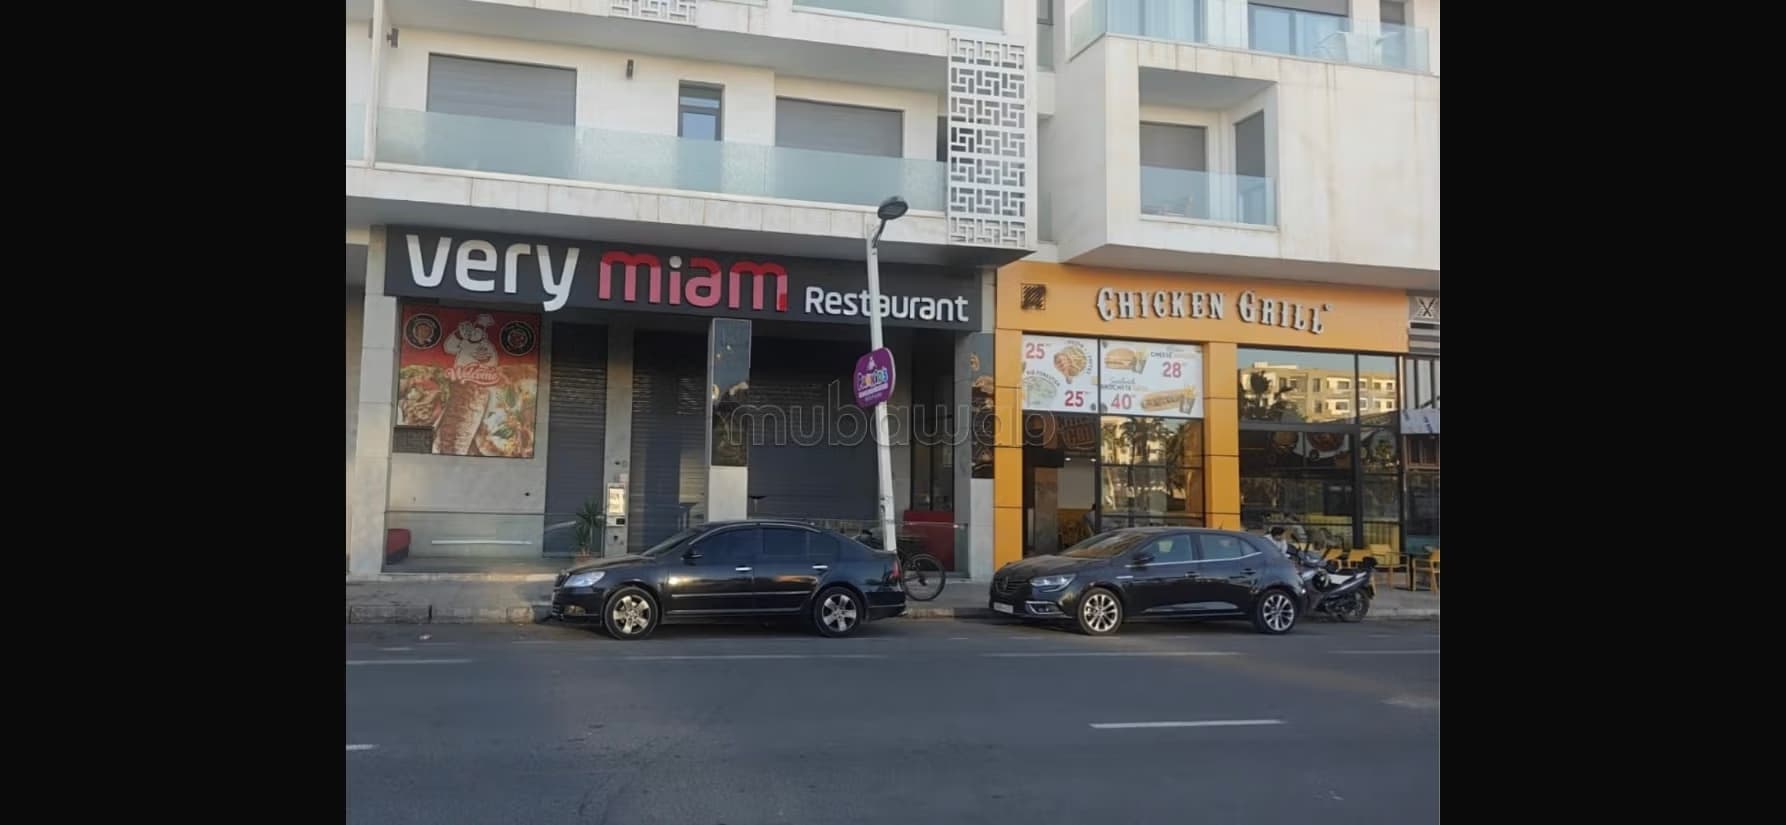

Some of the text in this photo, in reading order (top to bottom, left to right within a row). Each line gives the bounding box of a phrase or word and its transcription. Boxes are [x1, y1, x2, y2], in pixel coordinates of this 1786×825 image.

[406, 234, 969, 322] very miam Restaurant
[1097, 287, 1325, 334] CHICKEN GRILL
[1025, 342, 1046, 360] 25
[1162, 361, 1182, 378] 28
[1064, 390, 1085, 407] 25
[1111, 393, 1132, 410] 40
